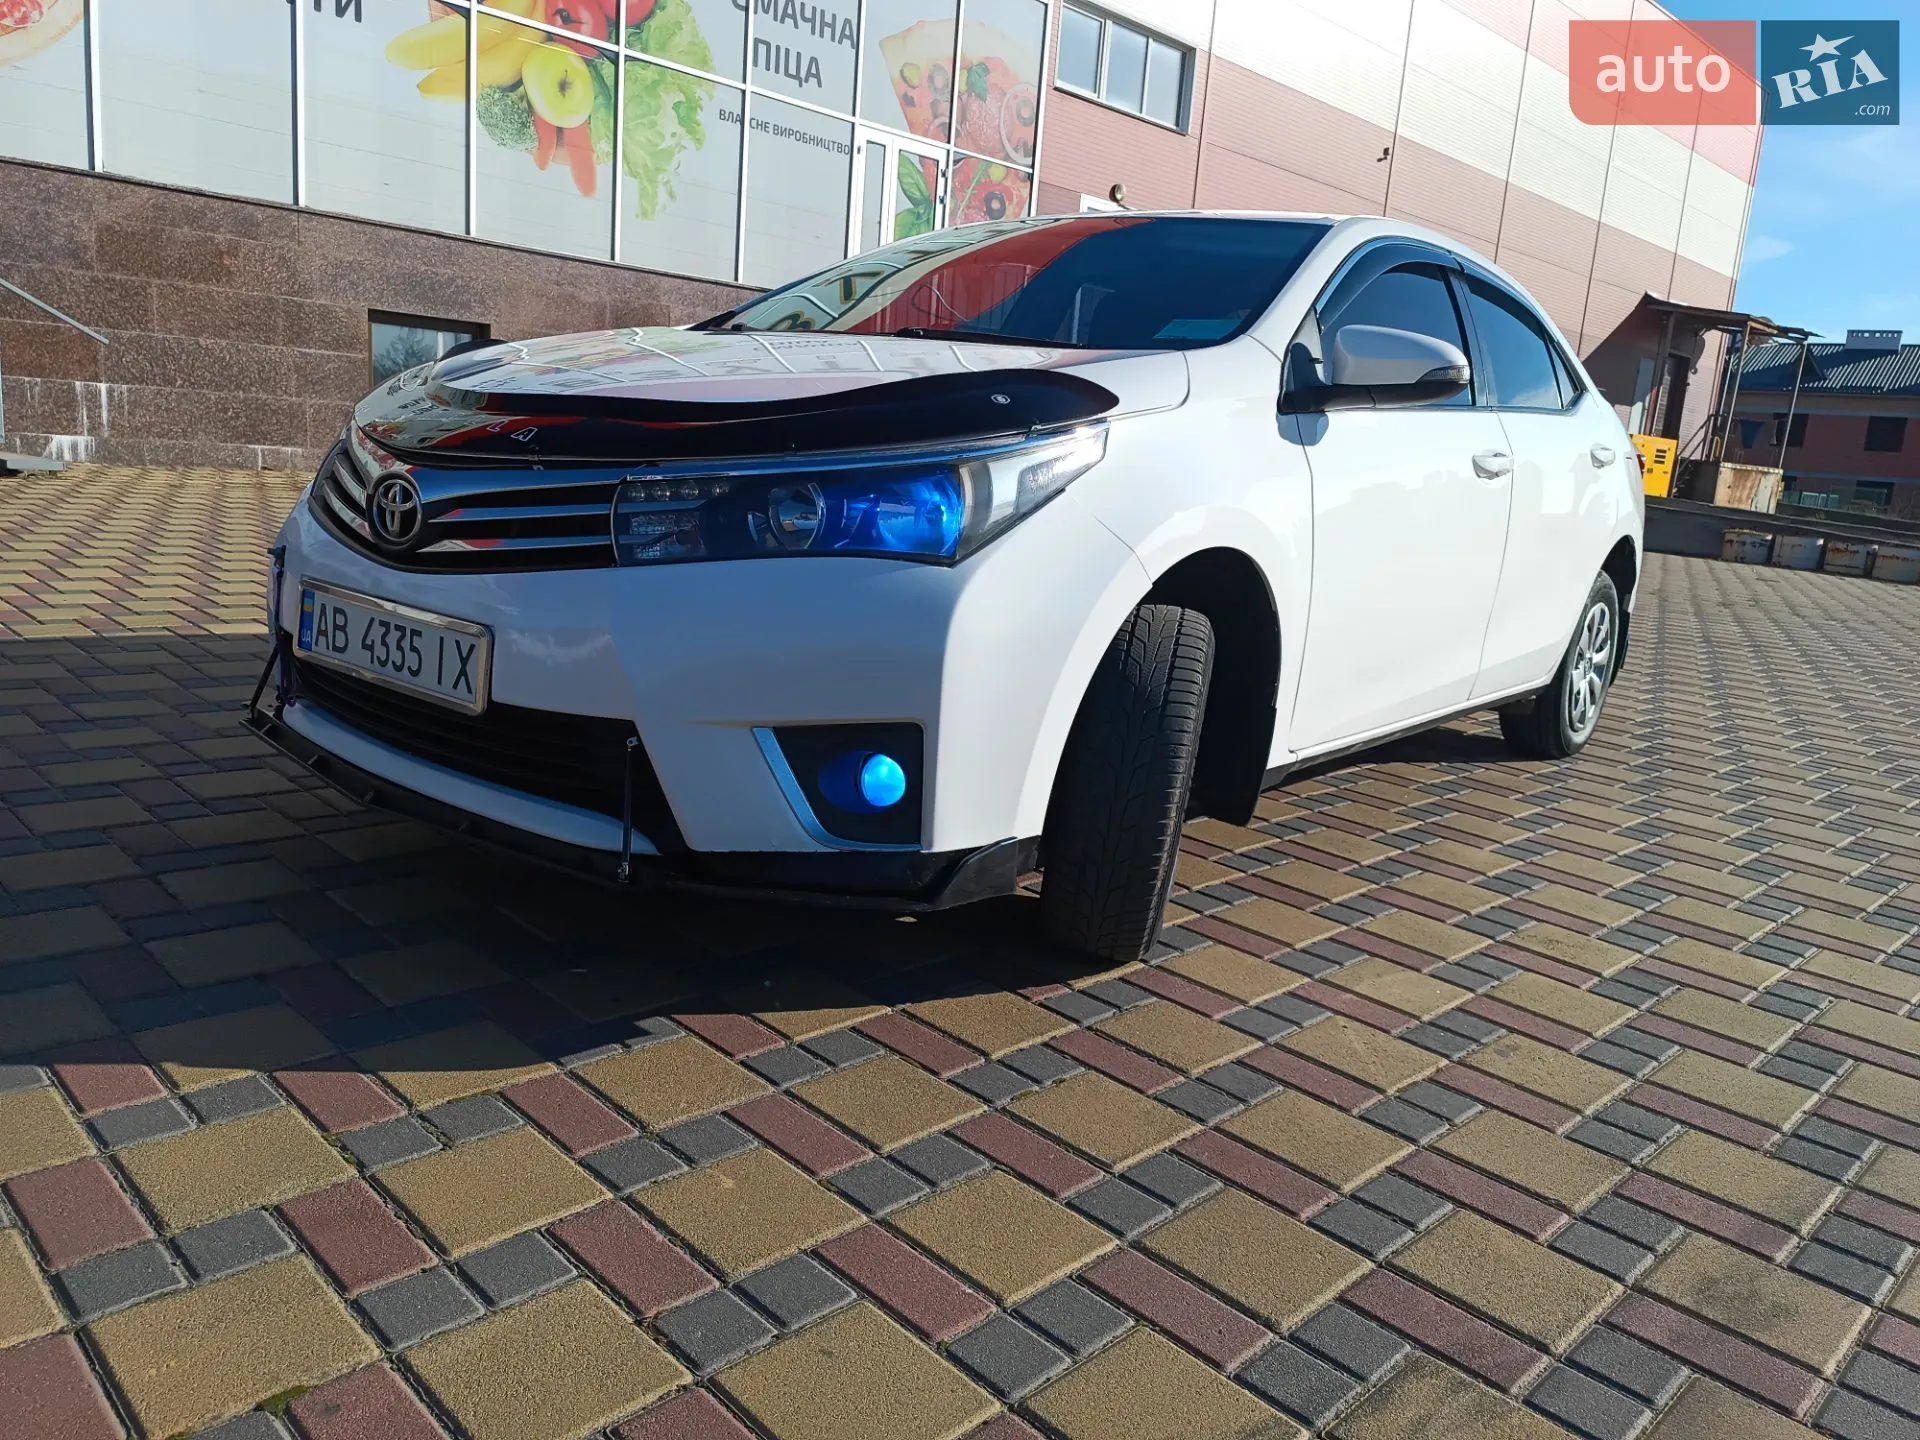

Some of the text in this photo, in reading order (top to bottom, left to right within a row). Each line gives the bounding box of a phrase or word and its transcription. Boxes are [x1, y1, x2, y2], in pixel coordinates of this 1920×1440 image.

[752, 37, 823, 89] ПІЦА
[772, 123, 850, 156] ВИРОБНИЦТВО
[301, 627, 311, 642] UA
[315, 603, 476, 695] AB 4335 IX
